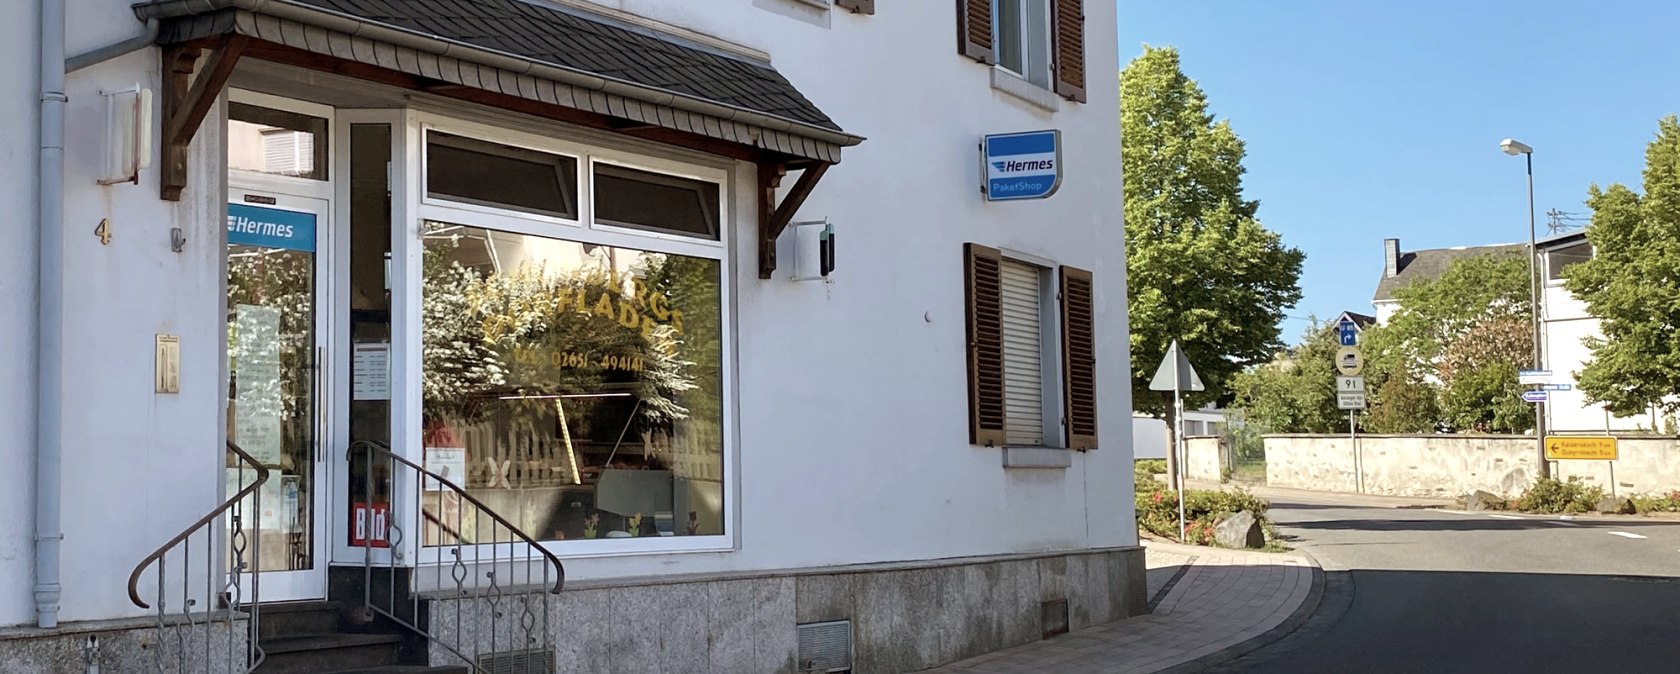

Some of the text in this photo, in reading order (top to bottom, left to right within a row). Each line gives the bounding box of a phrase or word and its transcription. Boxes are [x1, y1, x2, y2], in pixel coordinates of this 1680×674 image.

[1006, 160, 1053, 172] Hermes
[993, 181, 1042, 192] PaketShop
[94, 218, 112, 245] 4
[236, 216, 293, 238] Hermes
[601, 354, 645, 371] 494141
[355, 508, 386, 540] Bld
